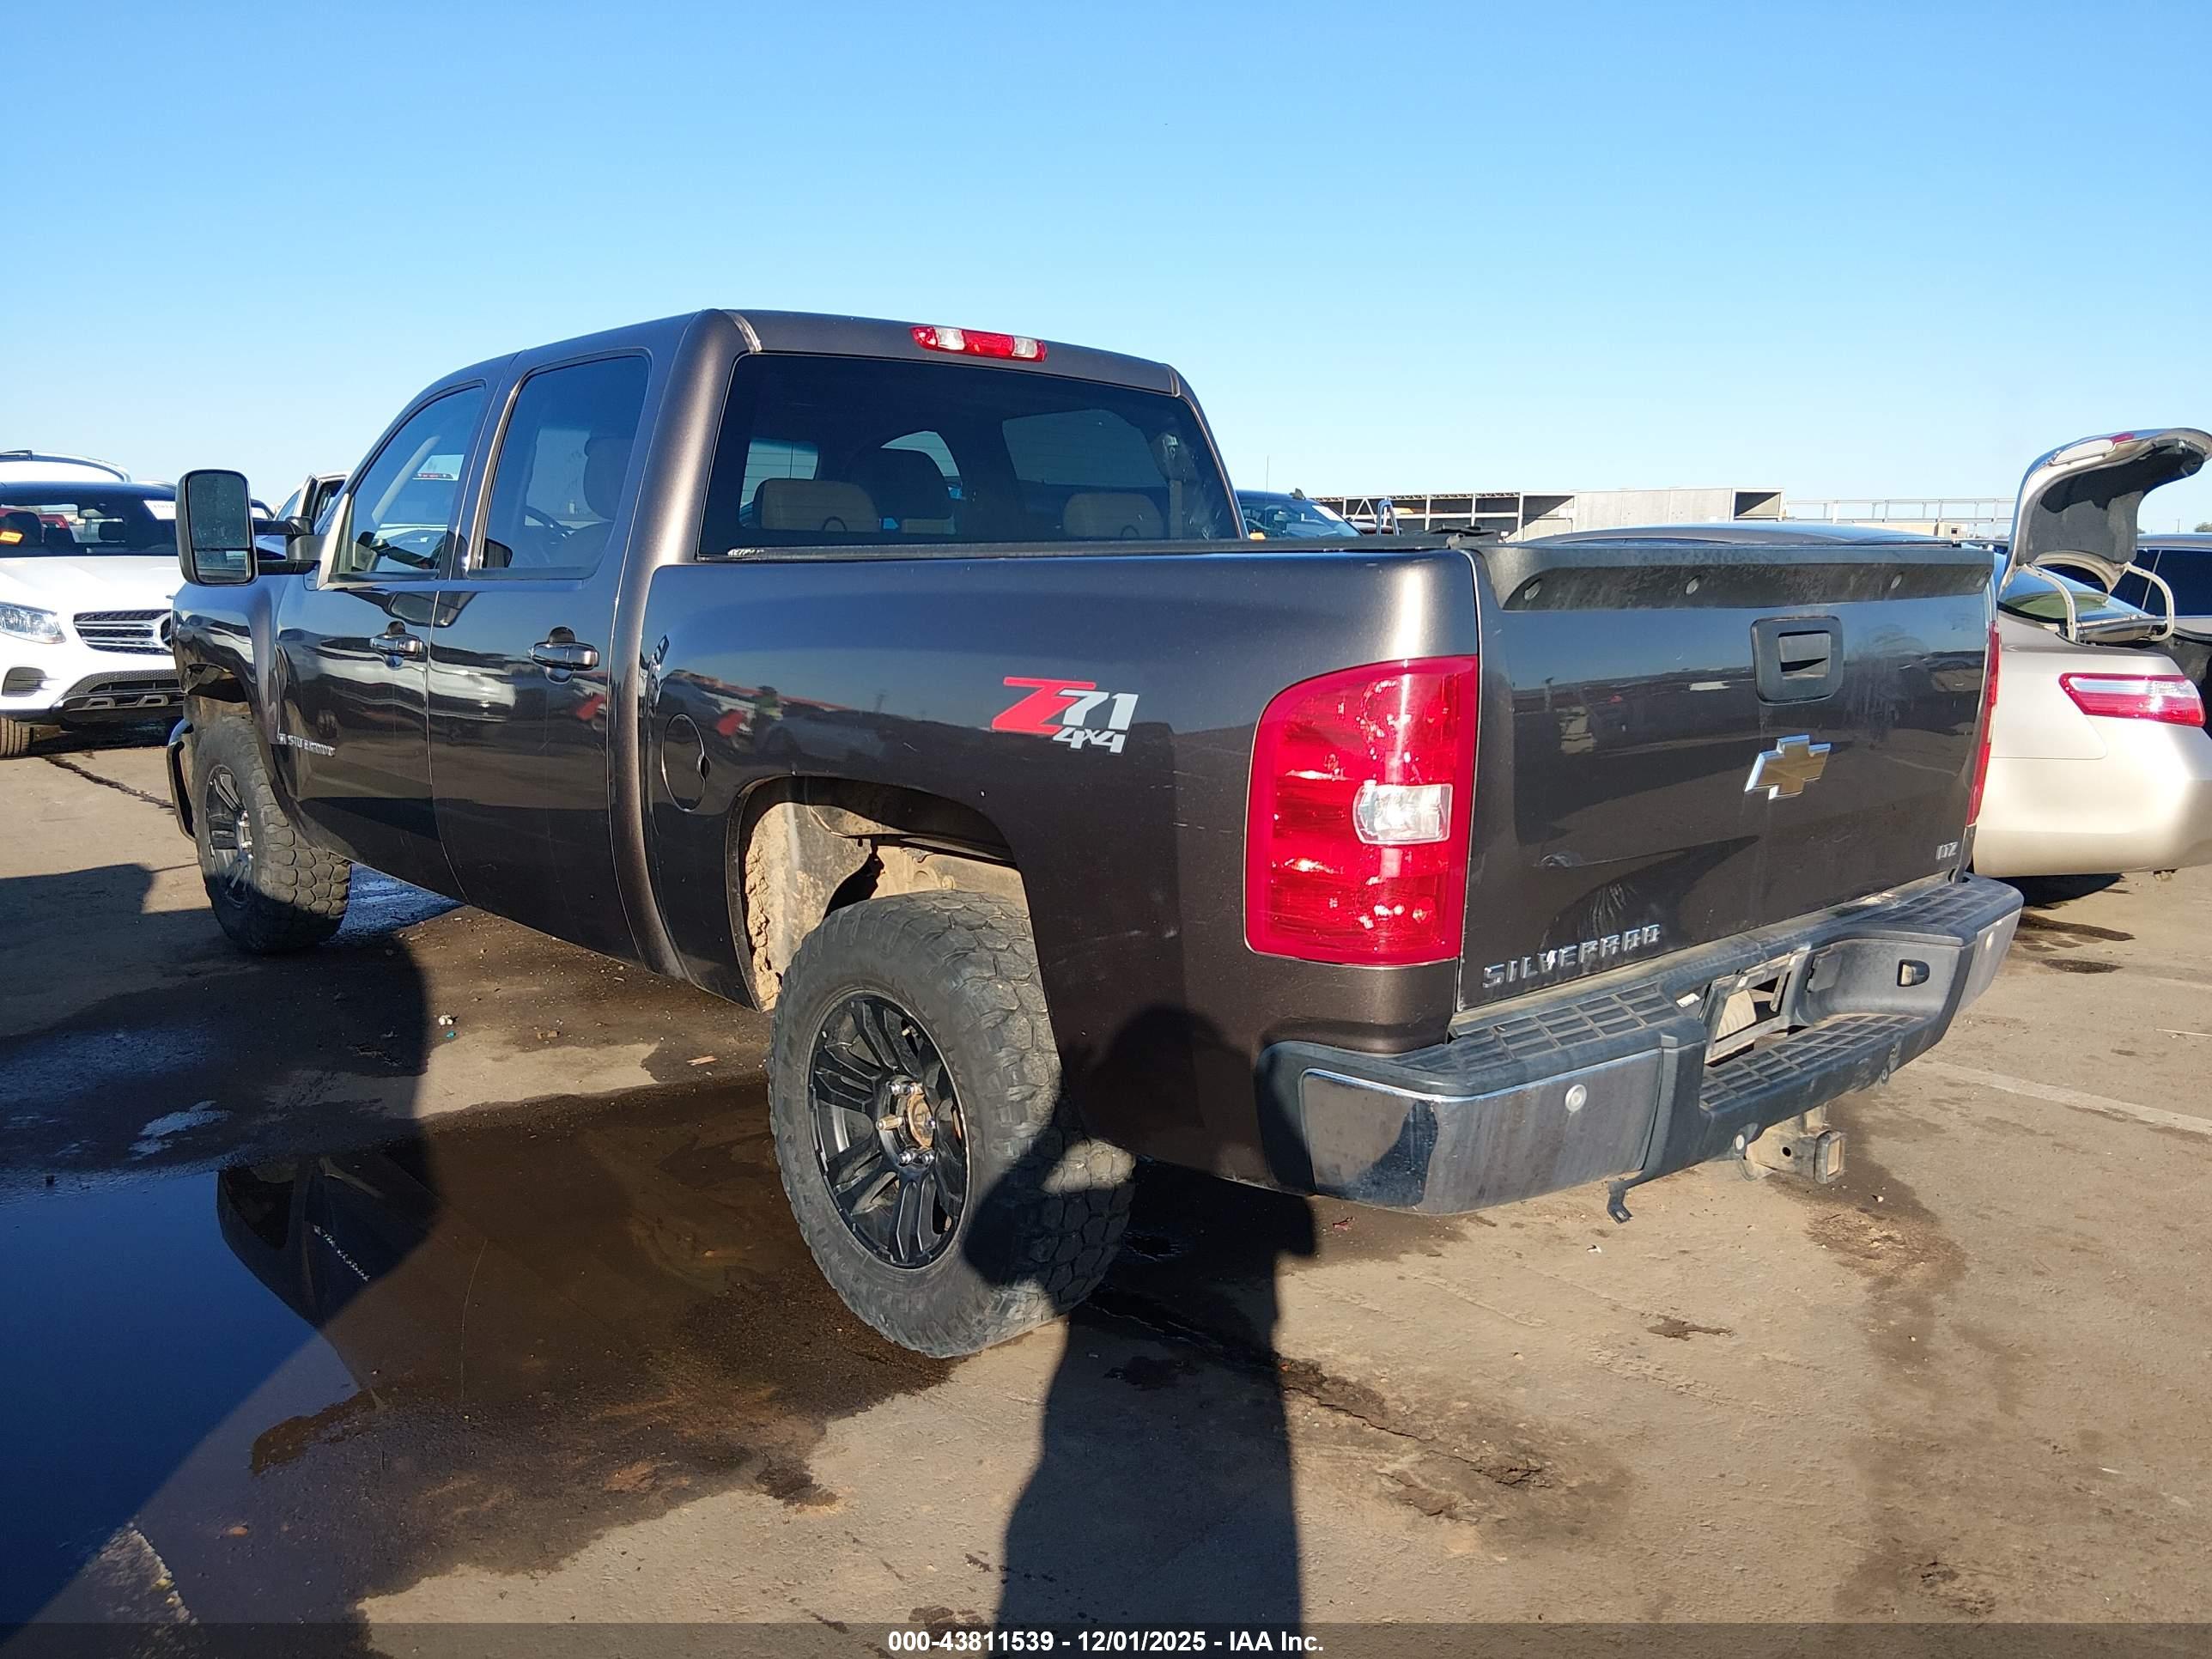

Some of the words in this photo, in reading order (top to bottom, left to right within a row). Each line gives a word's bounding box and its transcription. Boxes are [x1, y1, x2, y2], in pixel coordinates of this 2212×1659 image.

[992, 677, 1139, 734] Z71
[1936, 842, 1958, 860] LTZ
[1483, 924, 1660, 988] SILVERADO
